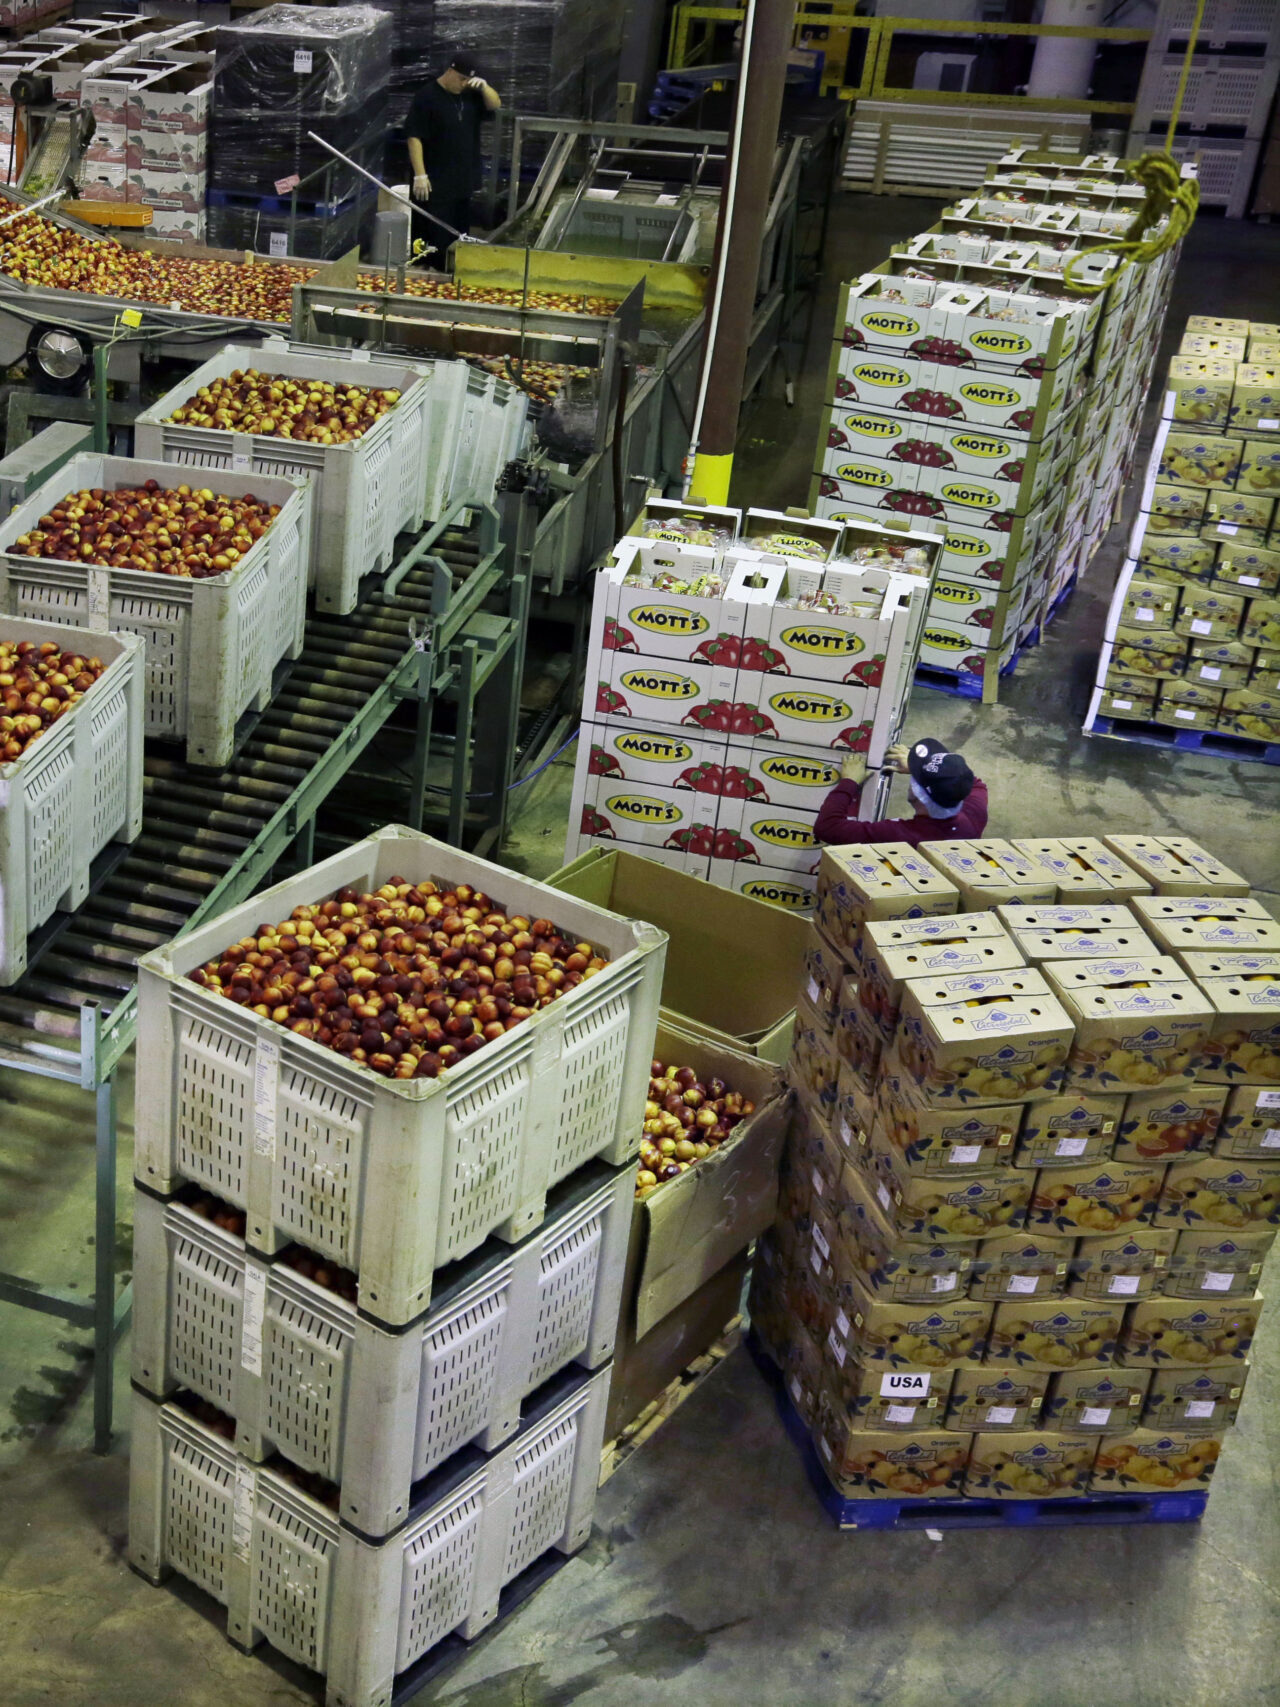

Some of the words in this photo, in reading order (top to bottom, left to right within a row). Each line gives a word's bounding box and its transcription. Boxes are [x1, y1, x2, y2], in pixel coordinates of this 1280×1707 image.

[867, 317, 913, 333] MOTT'S
[976, 335, 1024, 351] MOTT'S
[859, 368, 905, 384] MOTT'S
[966, 387, 1014, 403] MOTT'S
[851, 419, 896, 435] MOTT'S
[957, 439, 1004, 455] MOTT'S
[842, 468, 888, 485] MOTT'S
[947, 489, 994, 505] MOTT'S
[659, 533, 688, 544] MOTT'S
[636, 609, 700, 630] MOTT'S
[788, 631, 856, 652] MOTT'S
[629, 674, 691, 696] MOTT'S
[777, 696, 844, 718] MOTT'S
[623, 739, 684, 759] MOTT'S
[768, 761, 833, 782] MOTT'S
[613, 799, 674, 820] MOTT'S
[750, 885, 812, 906] MOTT'S
[1171, 1022, 1203, 1030] Oranges
[1028, 1038, 1060, 1047] Oranges
[995, 1177, 1024, 1185] Oranges
[1081, 1309, 1111, 1317] Oranges
[890, 1377, 923, 1388] USA
